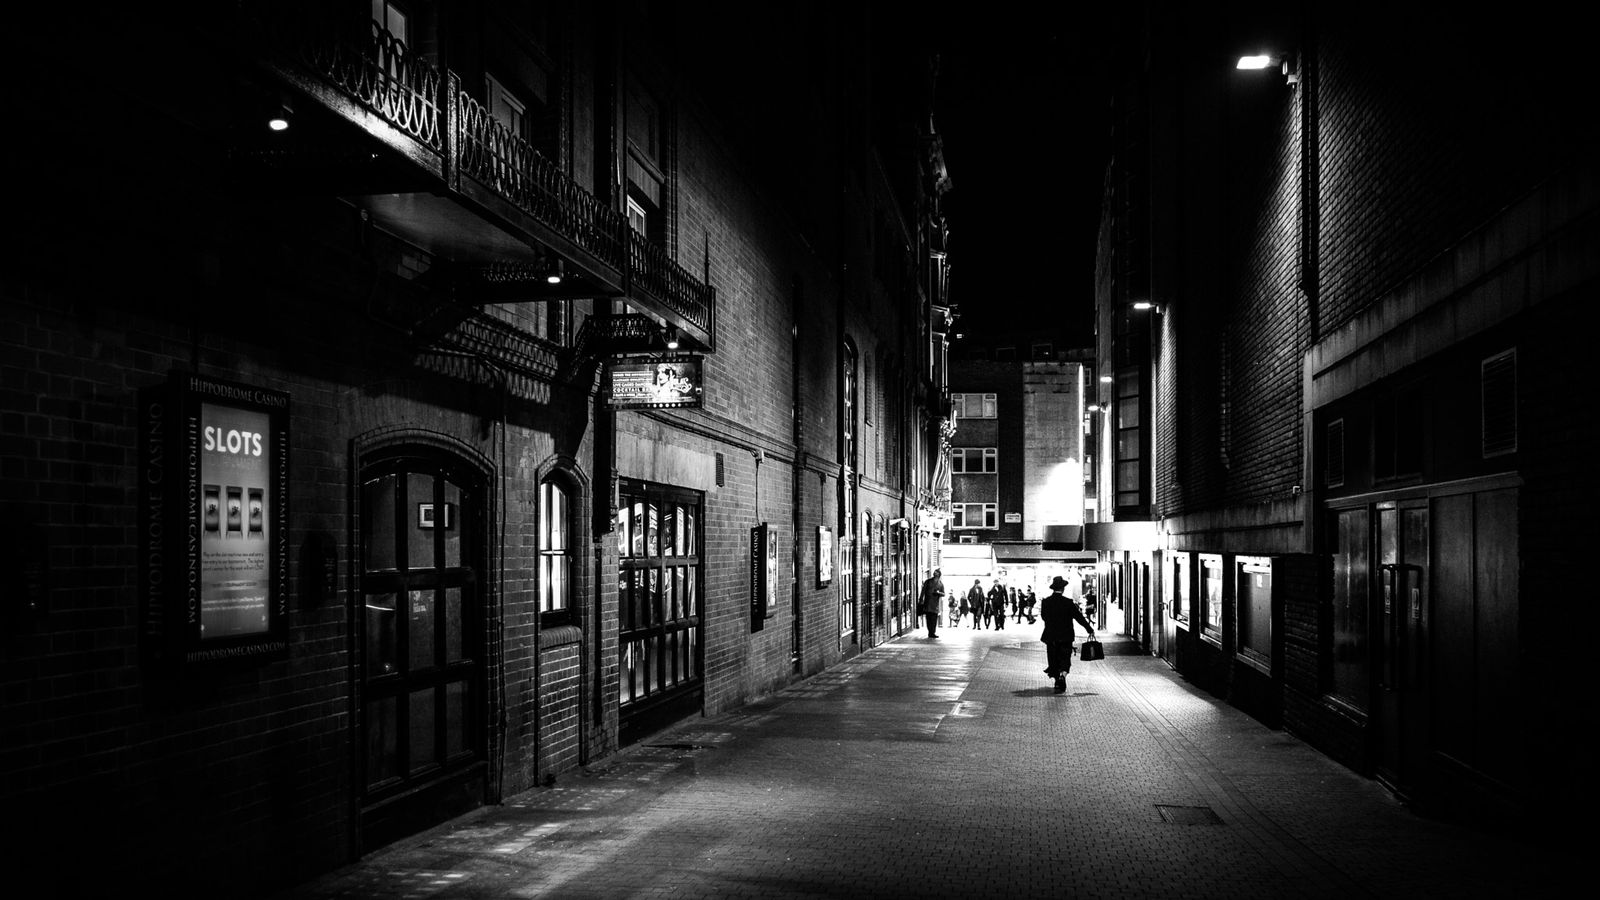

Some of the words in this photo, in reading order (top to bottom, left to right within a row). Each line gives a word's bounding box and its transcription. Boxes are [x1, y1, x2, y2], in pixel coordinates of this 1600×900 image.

[189, 376, 254, 402] HIPPODROME
[254, 390, 287, 408] CASINO
[147, 402, 164, 486] CASINO
[204, 425, 263, 457] SLOTS
[189, 417, 198, 624] HIPPODROMECASINO.COM
[145, 490, 164, 637] HIPPODROME
